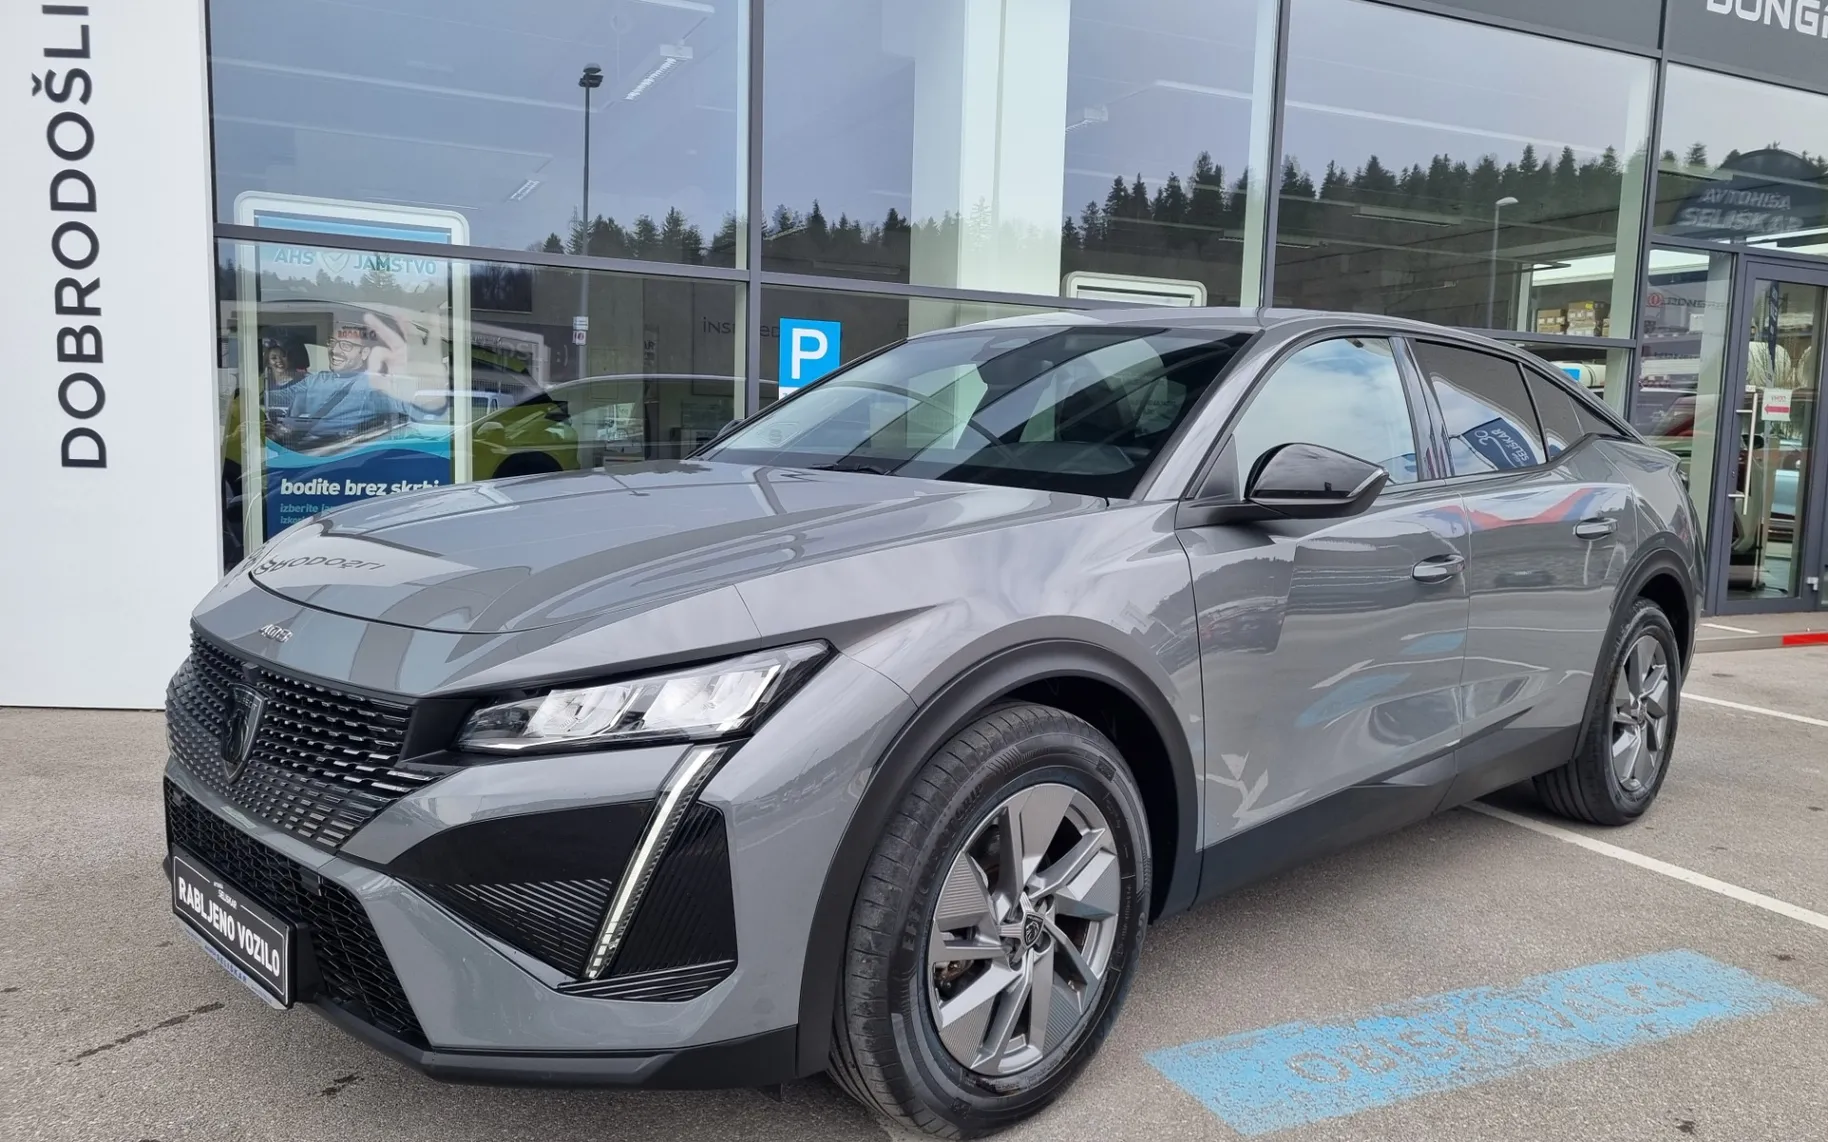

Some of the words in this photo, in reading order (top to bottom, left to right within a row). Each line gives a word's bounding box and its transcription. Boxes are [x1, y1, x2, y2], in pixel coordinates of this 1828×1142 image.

[31, 4, 108, 468] DOBRODOŠLI
[274, 248, 315, 266] AHS
[353, 254, 437, 275] JAMSTVO
[791, 328, 828, 379] P
[280, 478, 341, 496] bodite
[344, 478, 387, 496] brez
[280, 503, 319, 513] izberite
[178, 876, 236, 942] RABLJENO
[237, 921, 280, 977] VOZILO
